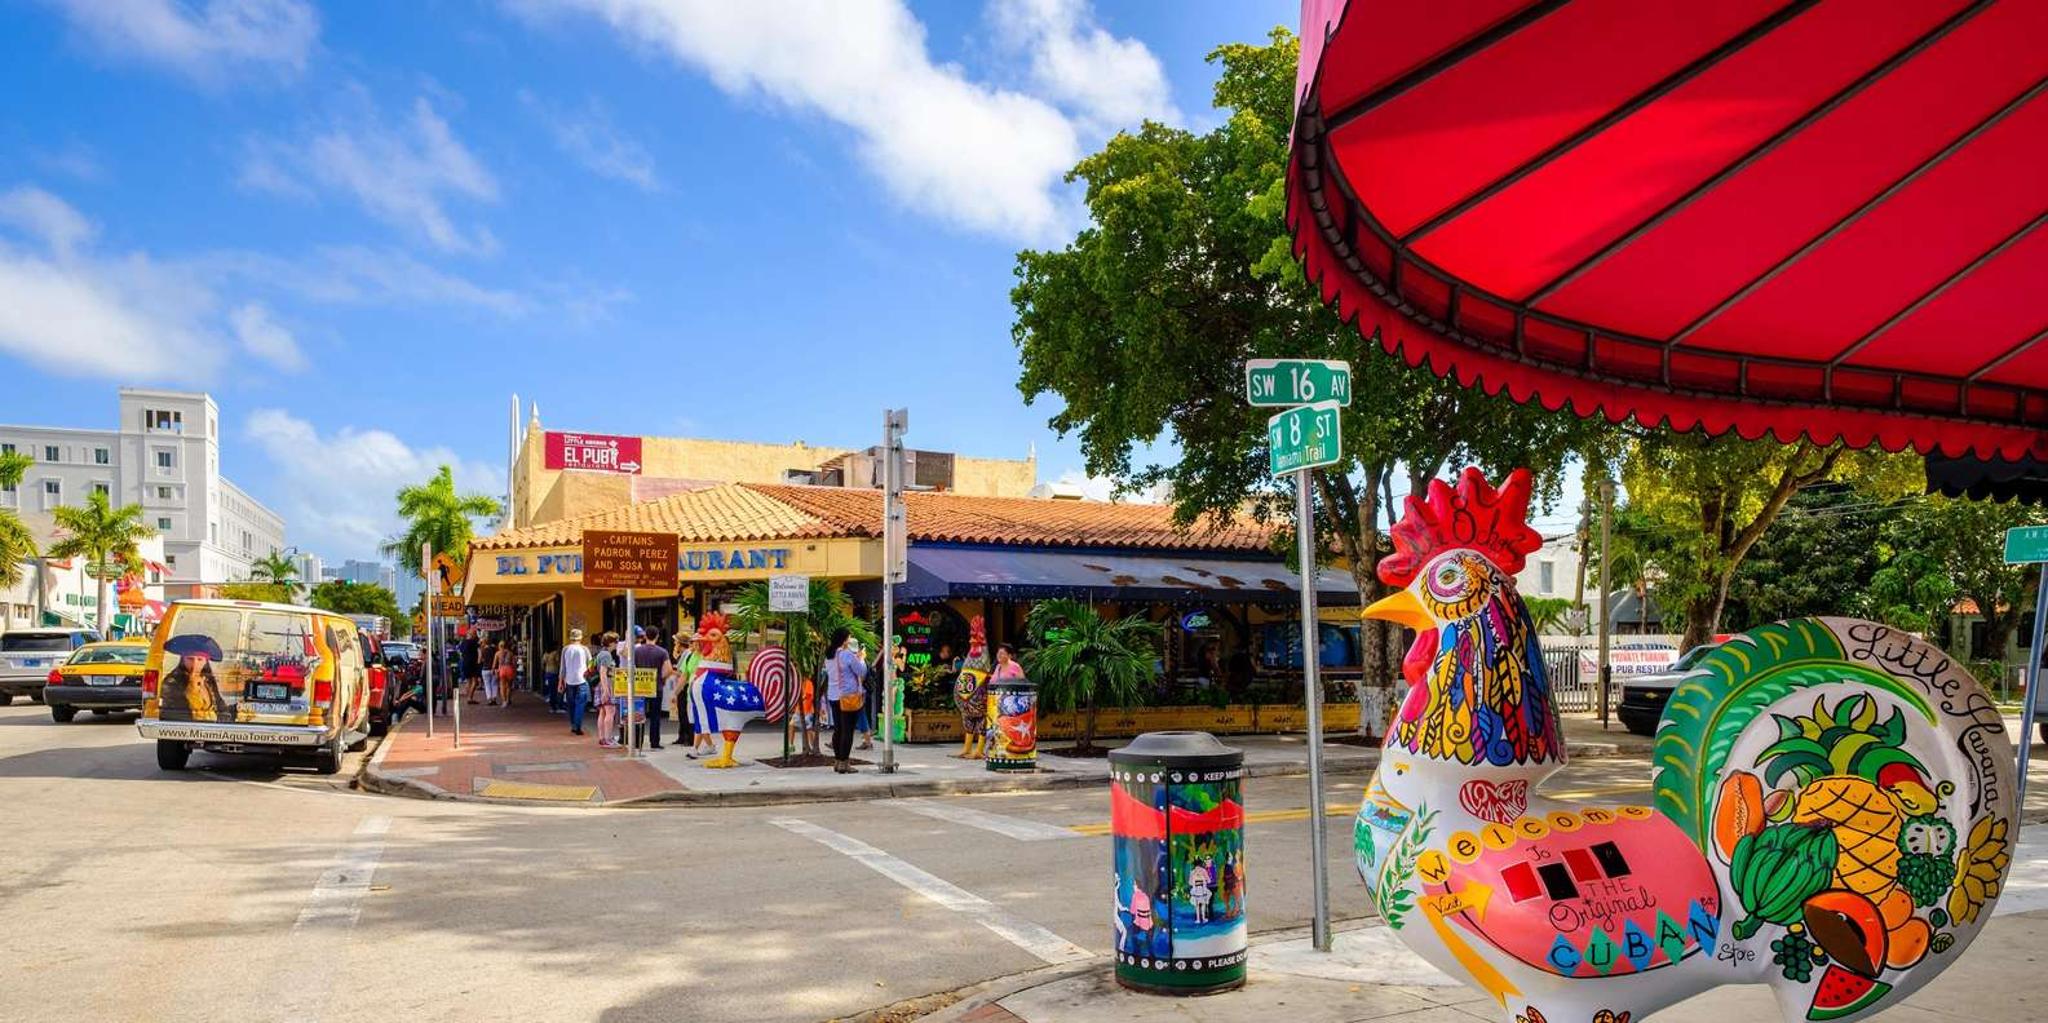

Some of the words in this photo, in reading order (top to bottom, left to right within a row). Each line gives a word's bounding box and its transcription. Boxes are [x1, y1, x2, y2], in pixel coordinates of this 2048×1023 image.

[1252, 374, 1275, 397] SW
[1290, 368, 1315, 401] 16
[1331, 375, 1345, 396] AV
[1272, 426, 1282, 450] SW
[1290, 413, 1301, 446] 8
[1316, 414, 1331, 438] ST
[564, 447, 580, 463] EL
[583, 448, 610, 465] PUB
[1304, 441, 1326, 463] Trail
[609, 535, 655, 547] CAPTAINS
[640, 549, 668, 559] PEREZ
[495, 556, 527, 576] EL
[594, 560, 613, 570] AND
[619, 560, 643, 571] SOSA
[649, 562, 668, 572] WAY
[908, 653, 931, 665] ATM
[1616, 665, 1633, 674] PUB
[1849, 624, 1960, 698] Little
[1941, 693, 2003, 820] Havana
[1203, 771, 1225, 781] KEEP
[1585, 877, 1634, 897] THE
[1431, 896, 1464, 914] Visit
[1550, 889, 1657, 933] Original
[1550, 913, 1717, 969] CUBAN
[1208, 956, 1236, 968] PLEASE
